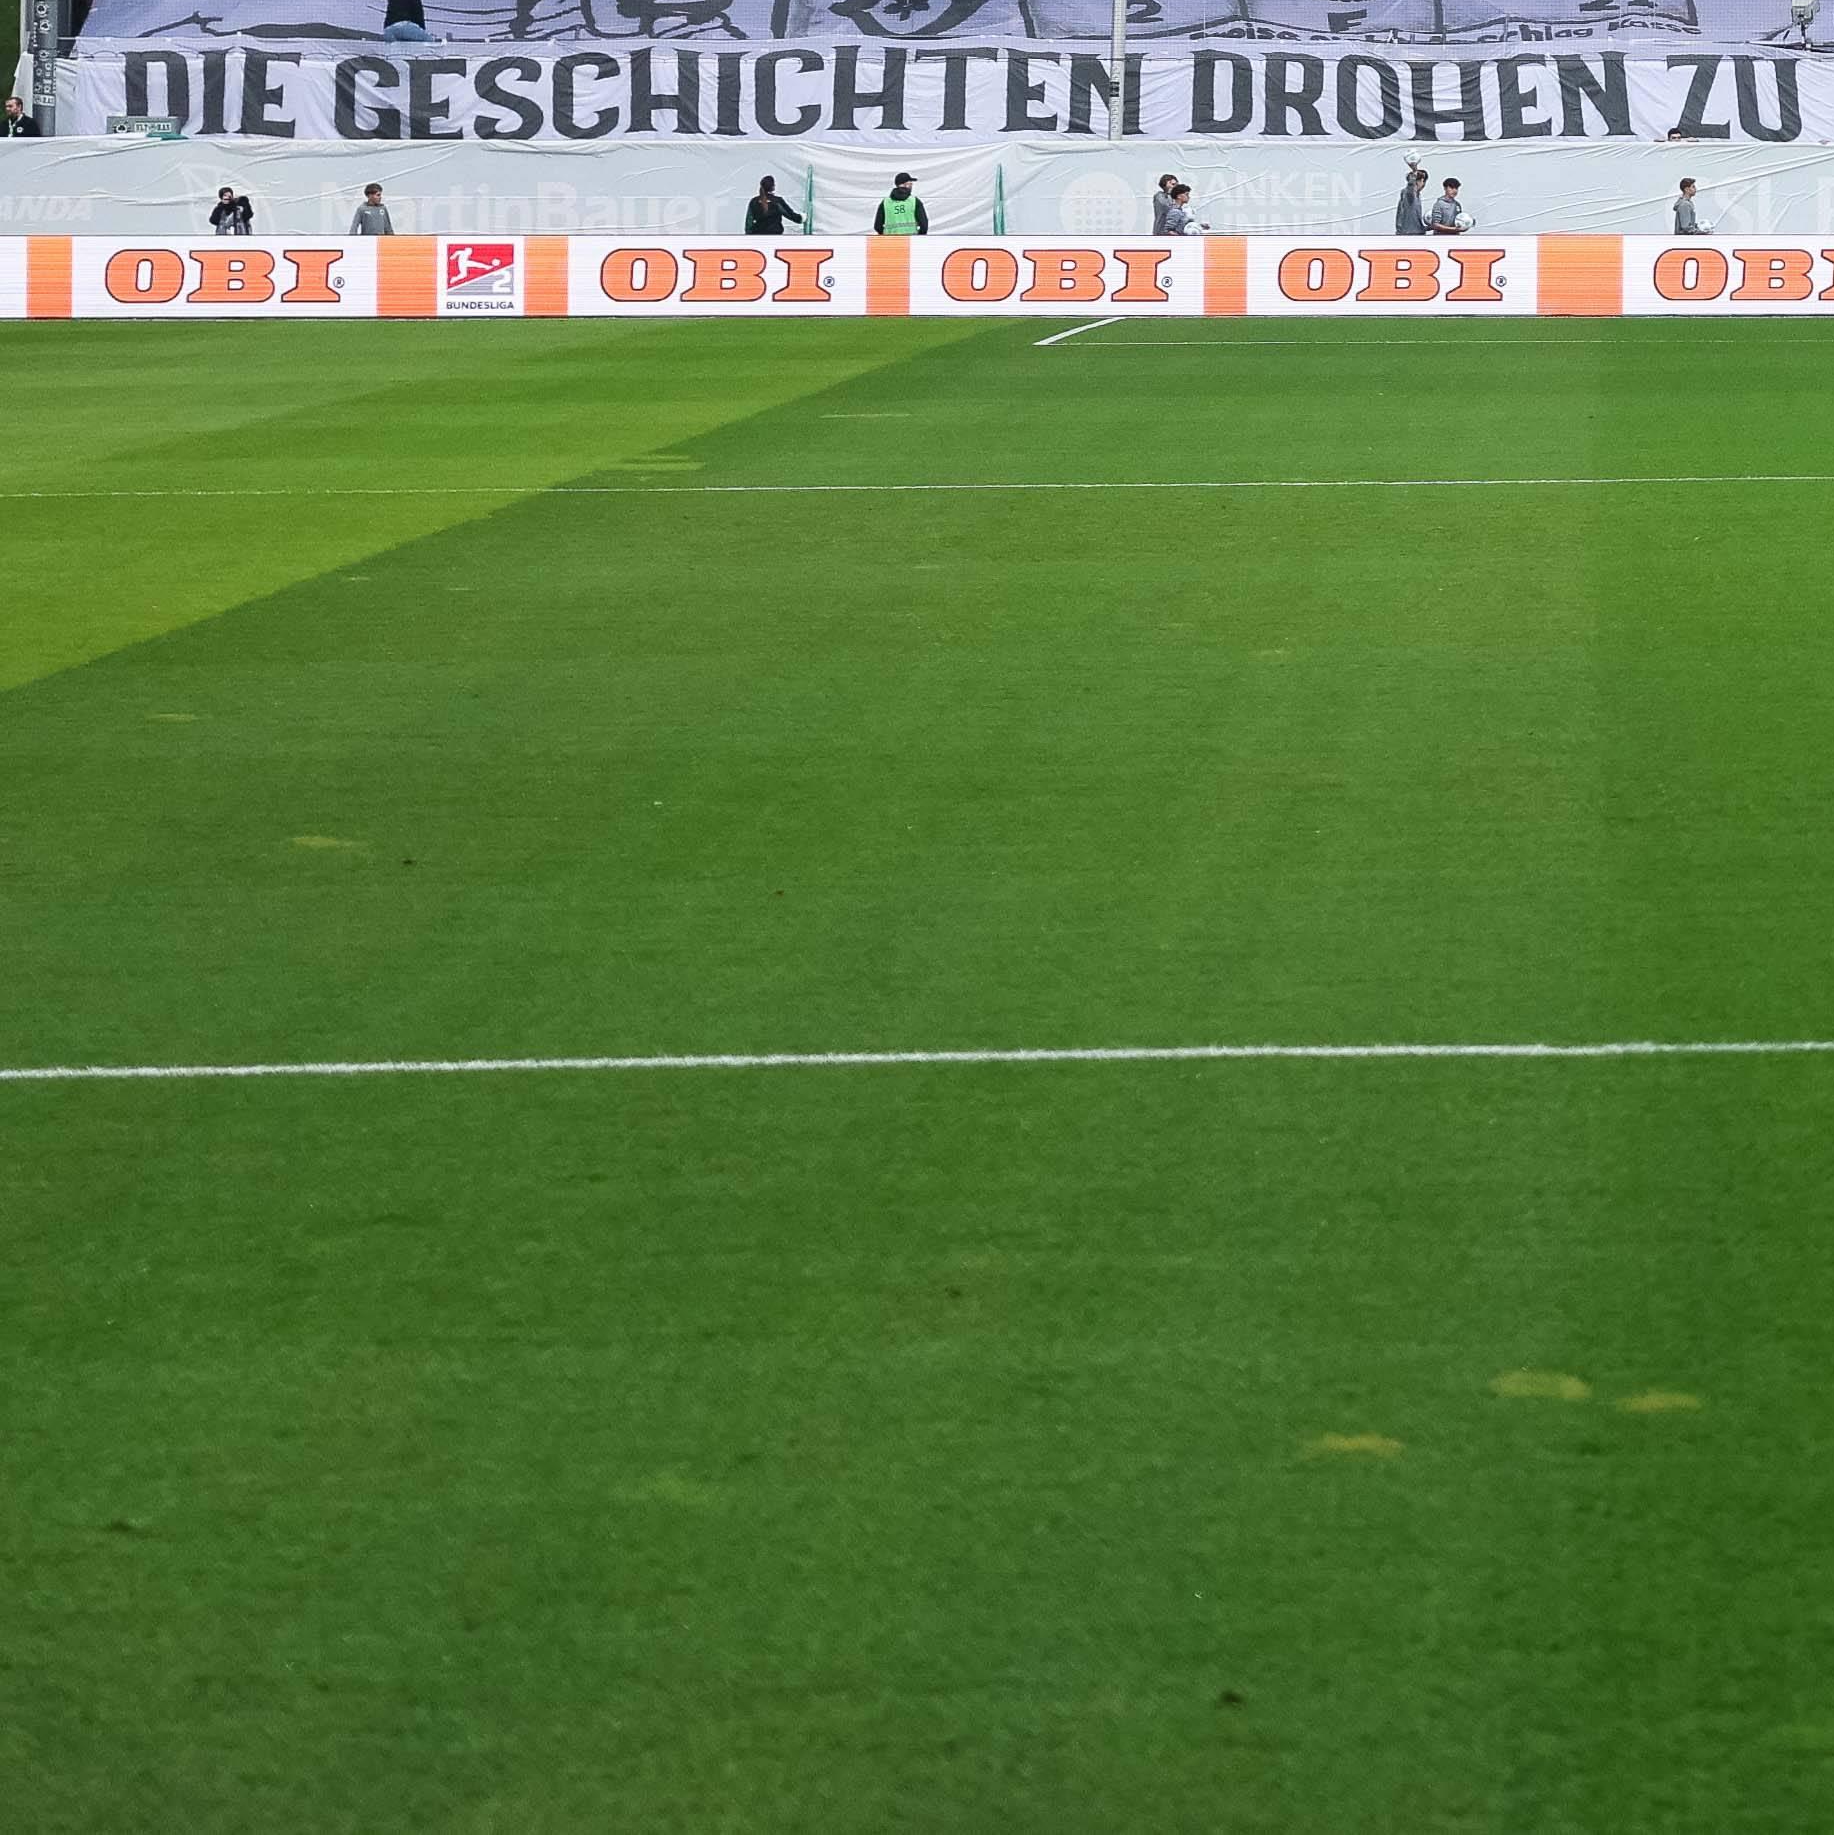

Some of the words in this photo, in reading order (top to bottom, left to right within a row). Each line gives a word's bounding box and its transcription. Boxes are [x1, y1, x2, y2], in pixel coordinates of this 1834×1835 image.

[124, 49, 302, 138] DIE
[335, 46, 1150, 141] GESCHICHTEN
[1189, 48, 1638, 142] DROHEN
[1665, 53, 1807, 143] ZU
[105, 248, 344, 303] OBI
[599, 248, 834, 303] OBI
[941, 248, 1172, 302] OBI
[1277, 248, 1506, 302] OBI
[446, 301, 516, 311] BUNDESLIGA
